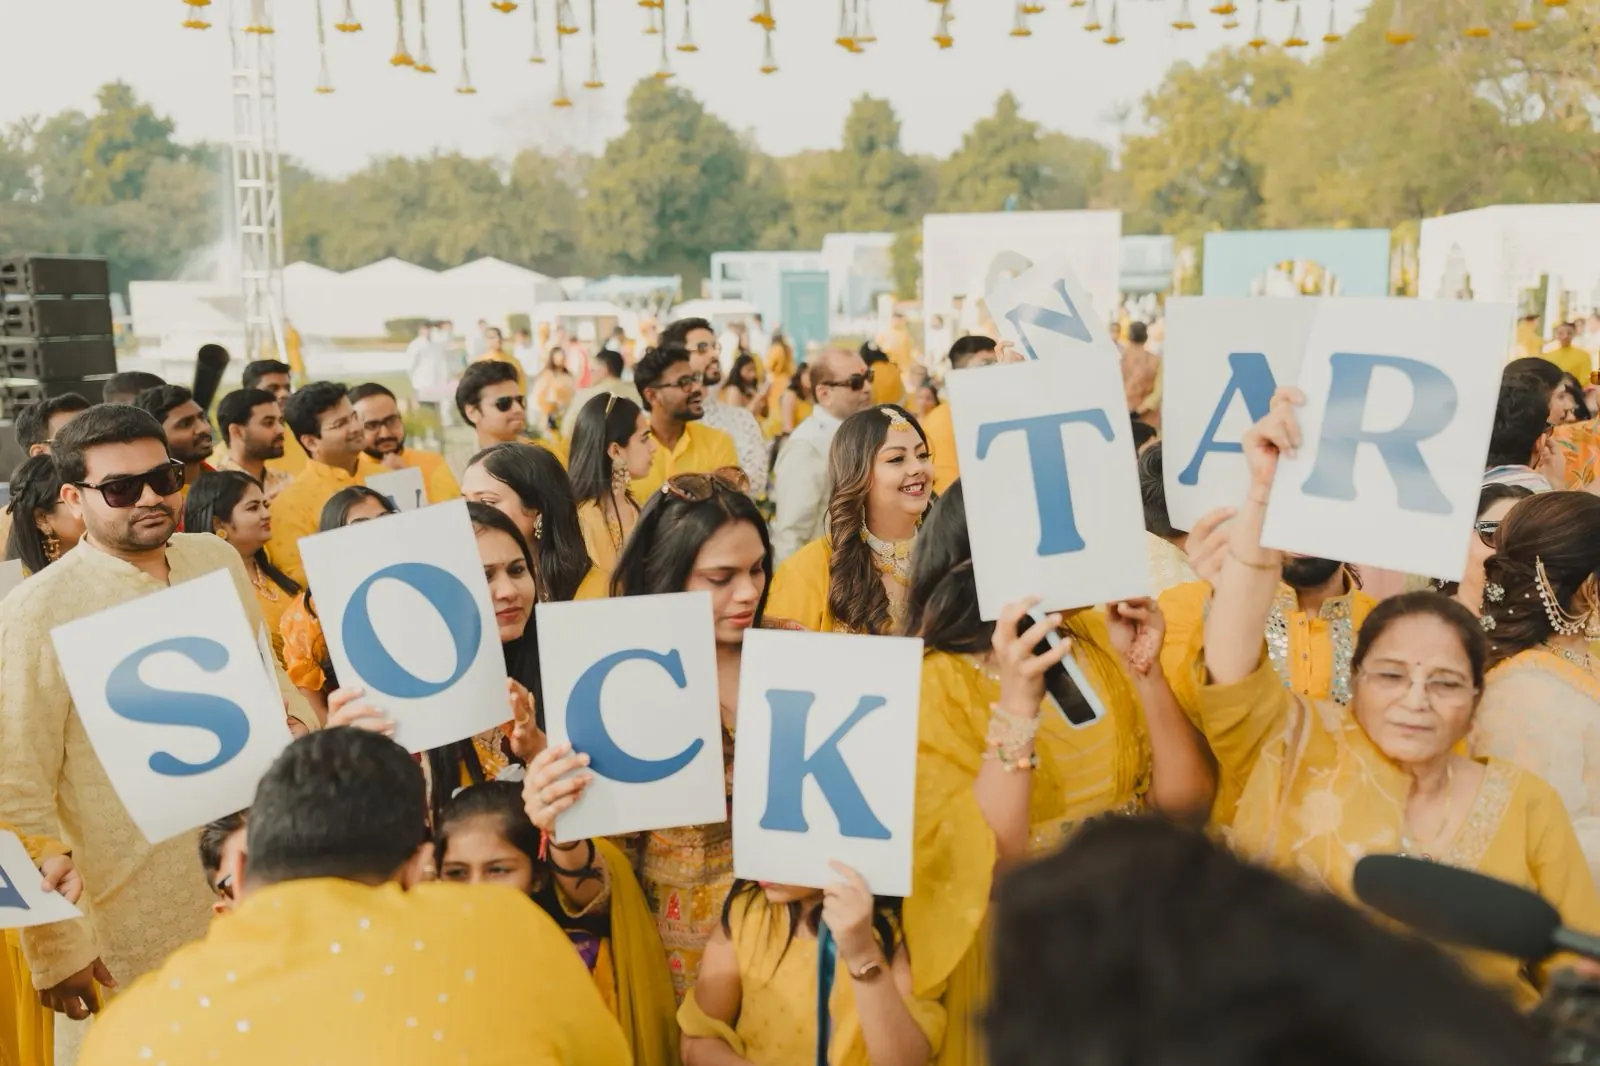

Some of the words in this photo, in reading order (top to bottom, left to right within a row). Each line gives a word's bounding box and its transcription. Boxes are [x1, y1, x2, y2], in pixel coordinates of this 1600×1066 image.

[976, 408, 1114, 557] T
[1178, 352, 1278, 486] A
[1301, 352, 1458, 516] R
[341, 562, 482, 699] O
[106, 636, 251, 777] S
[565, 648, 705, 784] C
[759, 689, 893, 840] K
